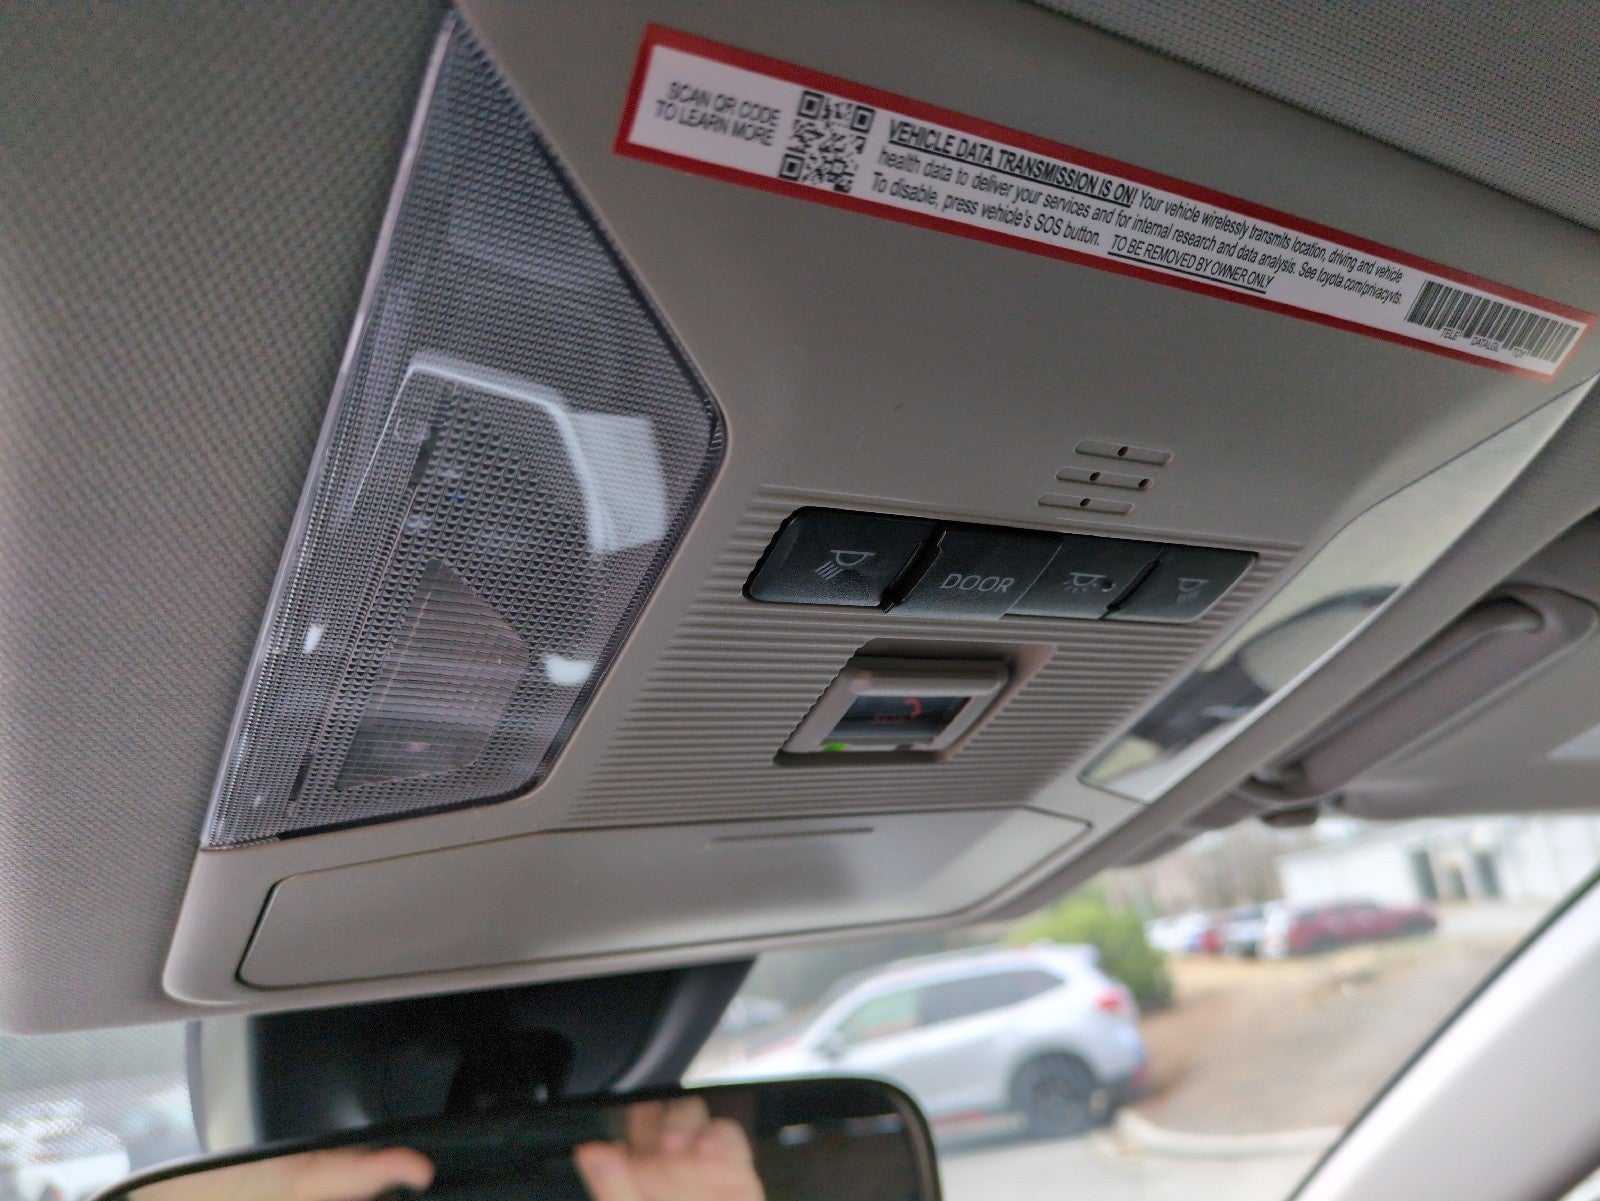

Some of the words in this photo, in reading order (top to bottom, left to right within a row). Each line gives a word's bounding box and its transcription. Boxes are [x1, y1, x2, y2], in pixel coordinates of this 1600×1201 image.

[656, 99, 676, 121] TO
[678, 107, 729, 135] LEARN
[731, 121, 775, 147] MORE
[668, 81, 710, 107] SCAN
[714, 94, 736, 116] QR
[740, 101, 781, 127] CODE
[872, 171, 888, 193] To
[889, 177, 939, 208] disable,
[942, 194, 979, 214] press
[981, 203, 1032, 229] vehicle's
[1034, 213, 1063, 236] SOS
[1063, 221, 1100, 246] button.
[1111, 234, 1128, 252] TO
[1127, 239, 1145, 256] BE
[1143, 243, 1197, 269] REMOVED
[1196, 257, 1213, 273] BY
[1211, 261, 1248, 283] OWNER
[1247, 271, 1275, 289] ONLY
[878, 146, 920, 174] health
[923, 160, 953, 182] data
[956, 167, 969, 186] to
[971, 172, 1014, 197] deliver
[1011, 185, 1043, 205] your
[1043, 193, 1091, 218] services
[1091, 207, 1116, 224] and
[1114, 210, 1133, 229] for
[1131, 214, 1173, 239] internal
[1171, 229, 1217, 252] research
[1216, 241, 1238, 257] and
[1236, 244, 1259, 263] data
[1258, 253, 1296, 274] analysis.
[1298, 261, 1318, 280] See
[889, 118, 956, 155] VEHICLE
[956, 138, 994, 166] DATA
[997, 149, 1099, 194] TRANSMISSION
[1099, 178, 1113, 198] IS
[1113, 183, 1138, 205] ON!
[1138, 190, 1164, 213] Your
[1165, 199, 1201, 223] vehicle
[1201, 211, 1249, 240] wirelessly
[1248, 224, 1291, 250] transmits
[1290, 236, 1327, 262] location,
[1327, 249, 1358, 273] driving
[1357, 261, 1377, 275] and
[1375, 264, 1403, 283] vehicle
[940, 573, 1015, 593] DOOR
